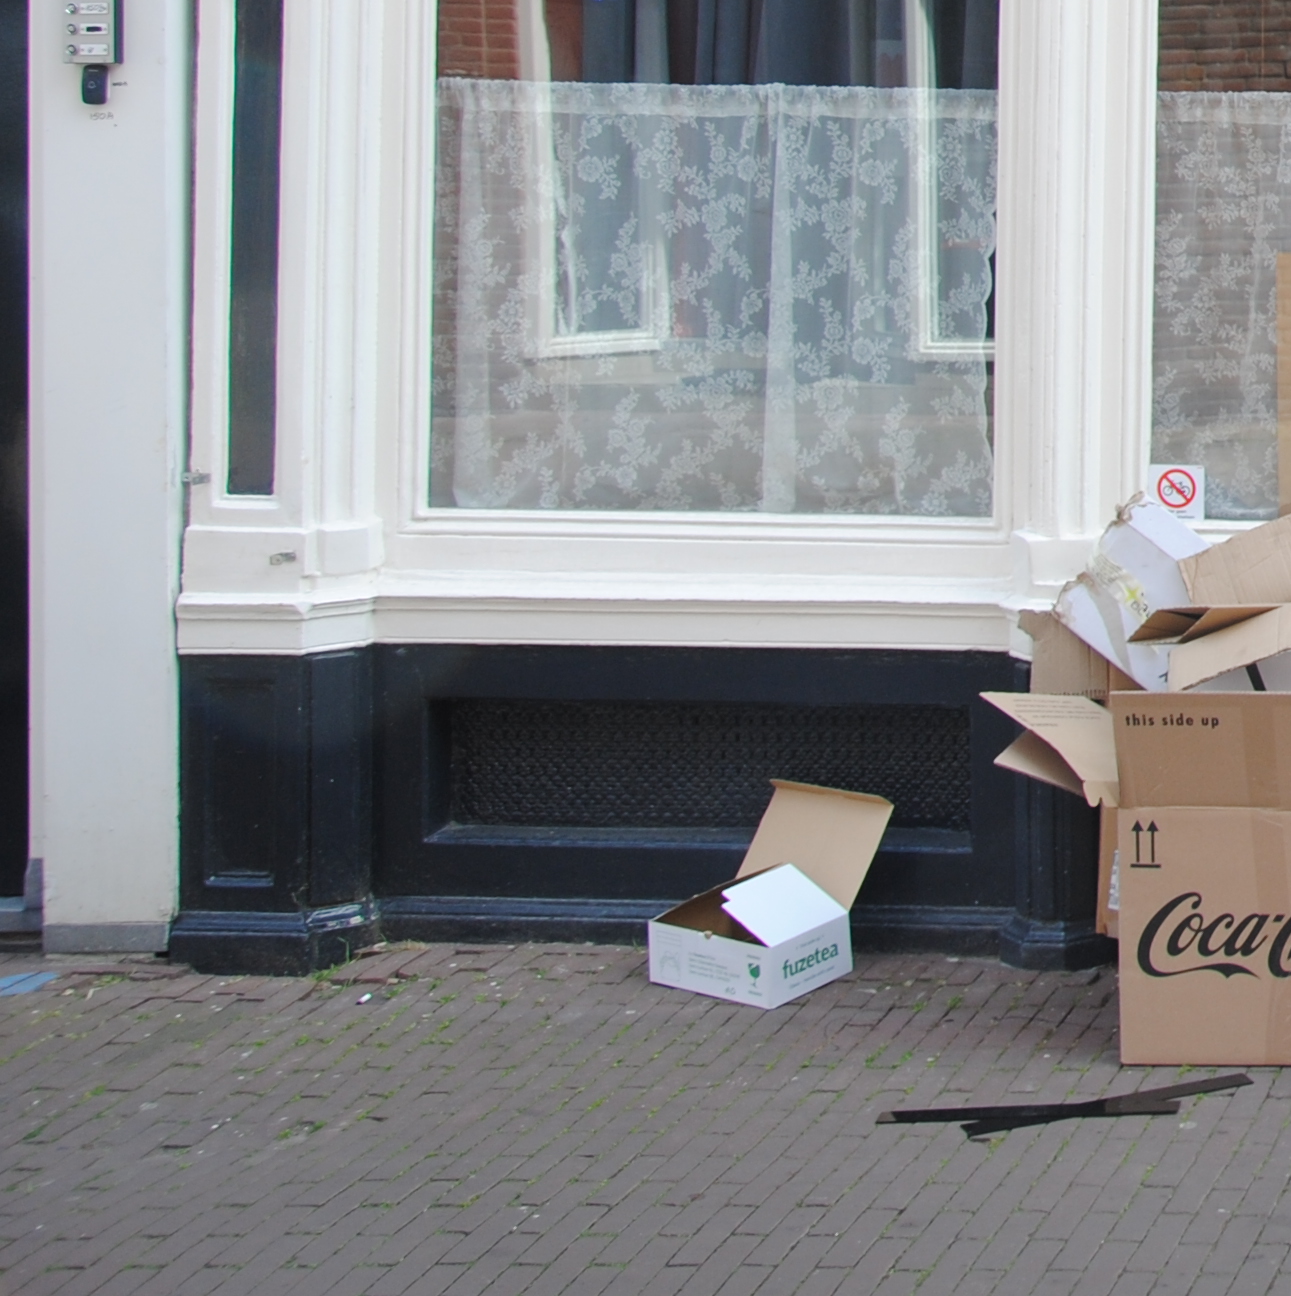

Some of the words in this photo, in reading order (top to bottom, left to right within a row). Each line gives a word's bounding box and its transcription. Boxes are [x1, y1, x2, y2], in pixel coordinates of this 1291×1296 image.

[1125, 713, 1155, 727] this
[1161, 713, 1194, 727] side
[1201, 715, 1220, 729] up
[782, 943, 839, 980] fuzetea
